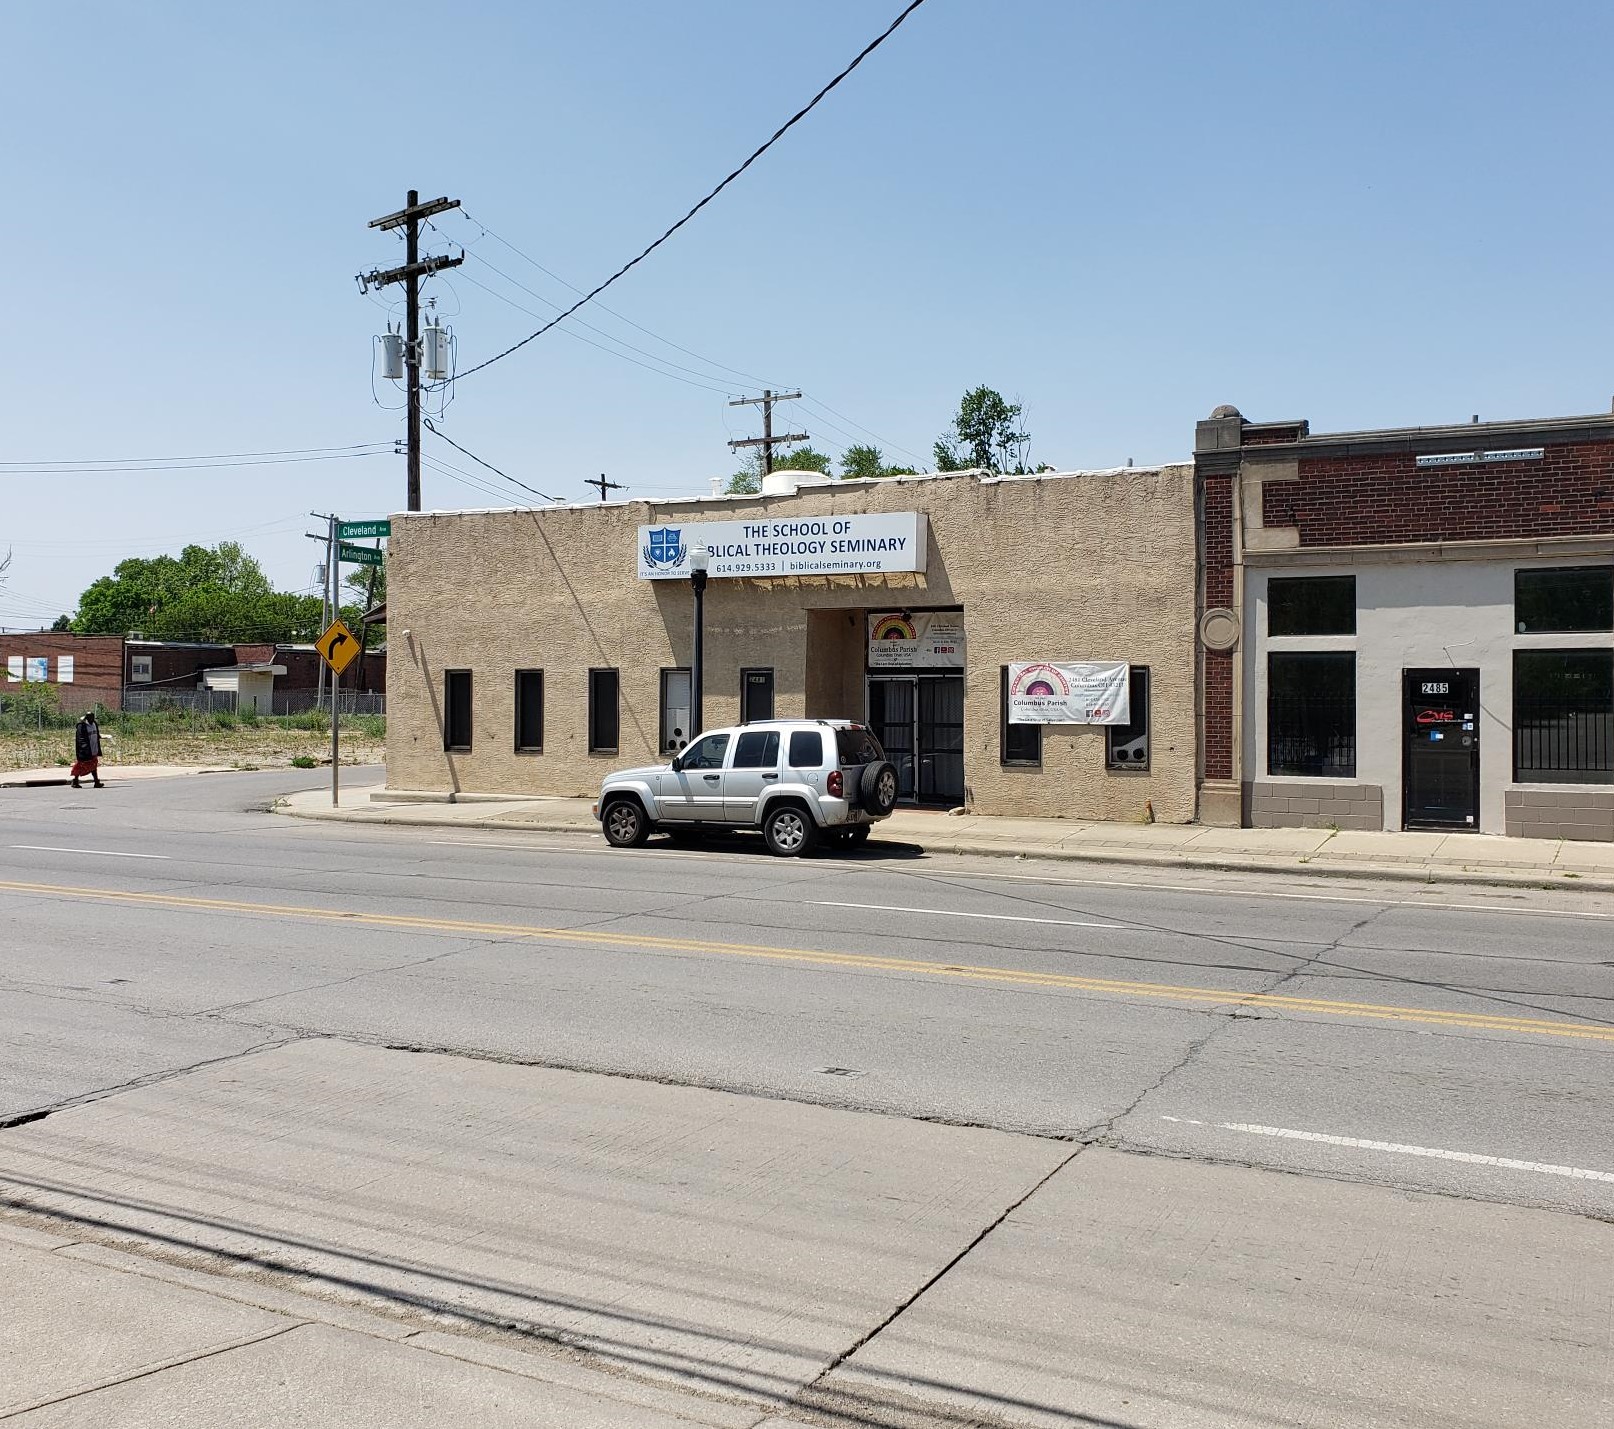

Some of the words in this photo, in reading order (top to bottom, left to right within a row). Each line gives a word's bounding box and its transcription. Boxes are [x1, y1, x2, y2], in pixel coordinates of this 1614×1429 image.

[342, 525, 377, 536] Cleveland
[743, 525, 769, 539] THE
[772, 522, 829, 537] SCHOOL
[832, 522, 851, 534] OF
[708, 544, 751, 558] BLICAL
[754, 541, 826, 556] THEOLOGY
[830, 538, 906, 553] SEMINARY
[341, 548, 372, 562] Arlington
[716, 562, 776, 573] 614.929.5333
[790, 560, 882, 570] biblicalseminary.org
[1422, 684, 1448, 692] 2485
